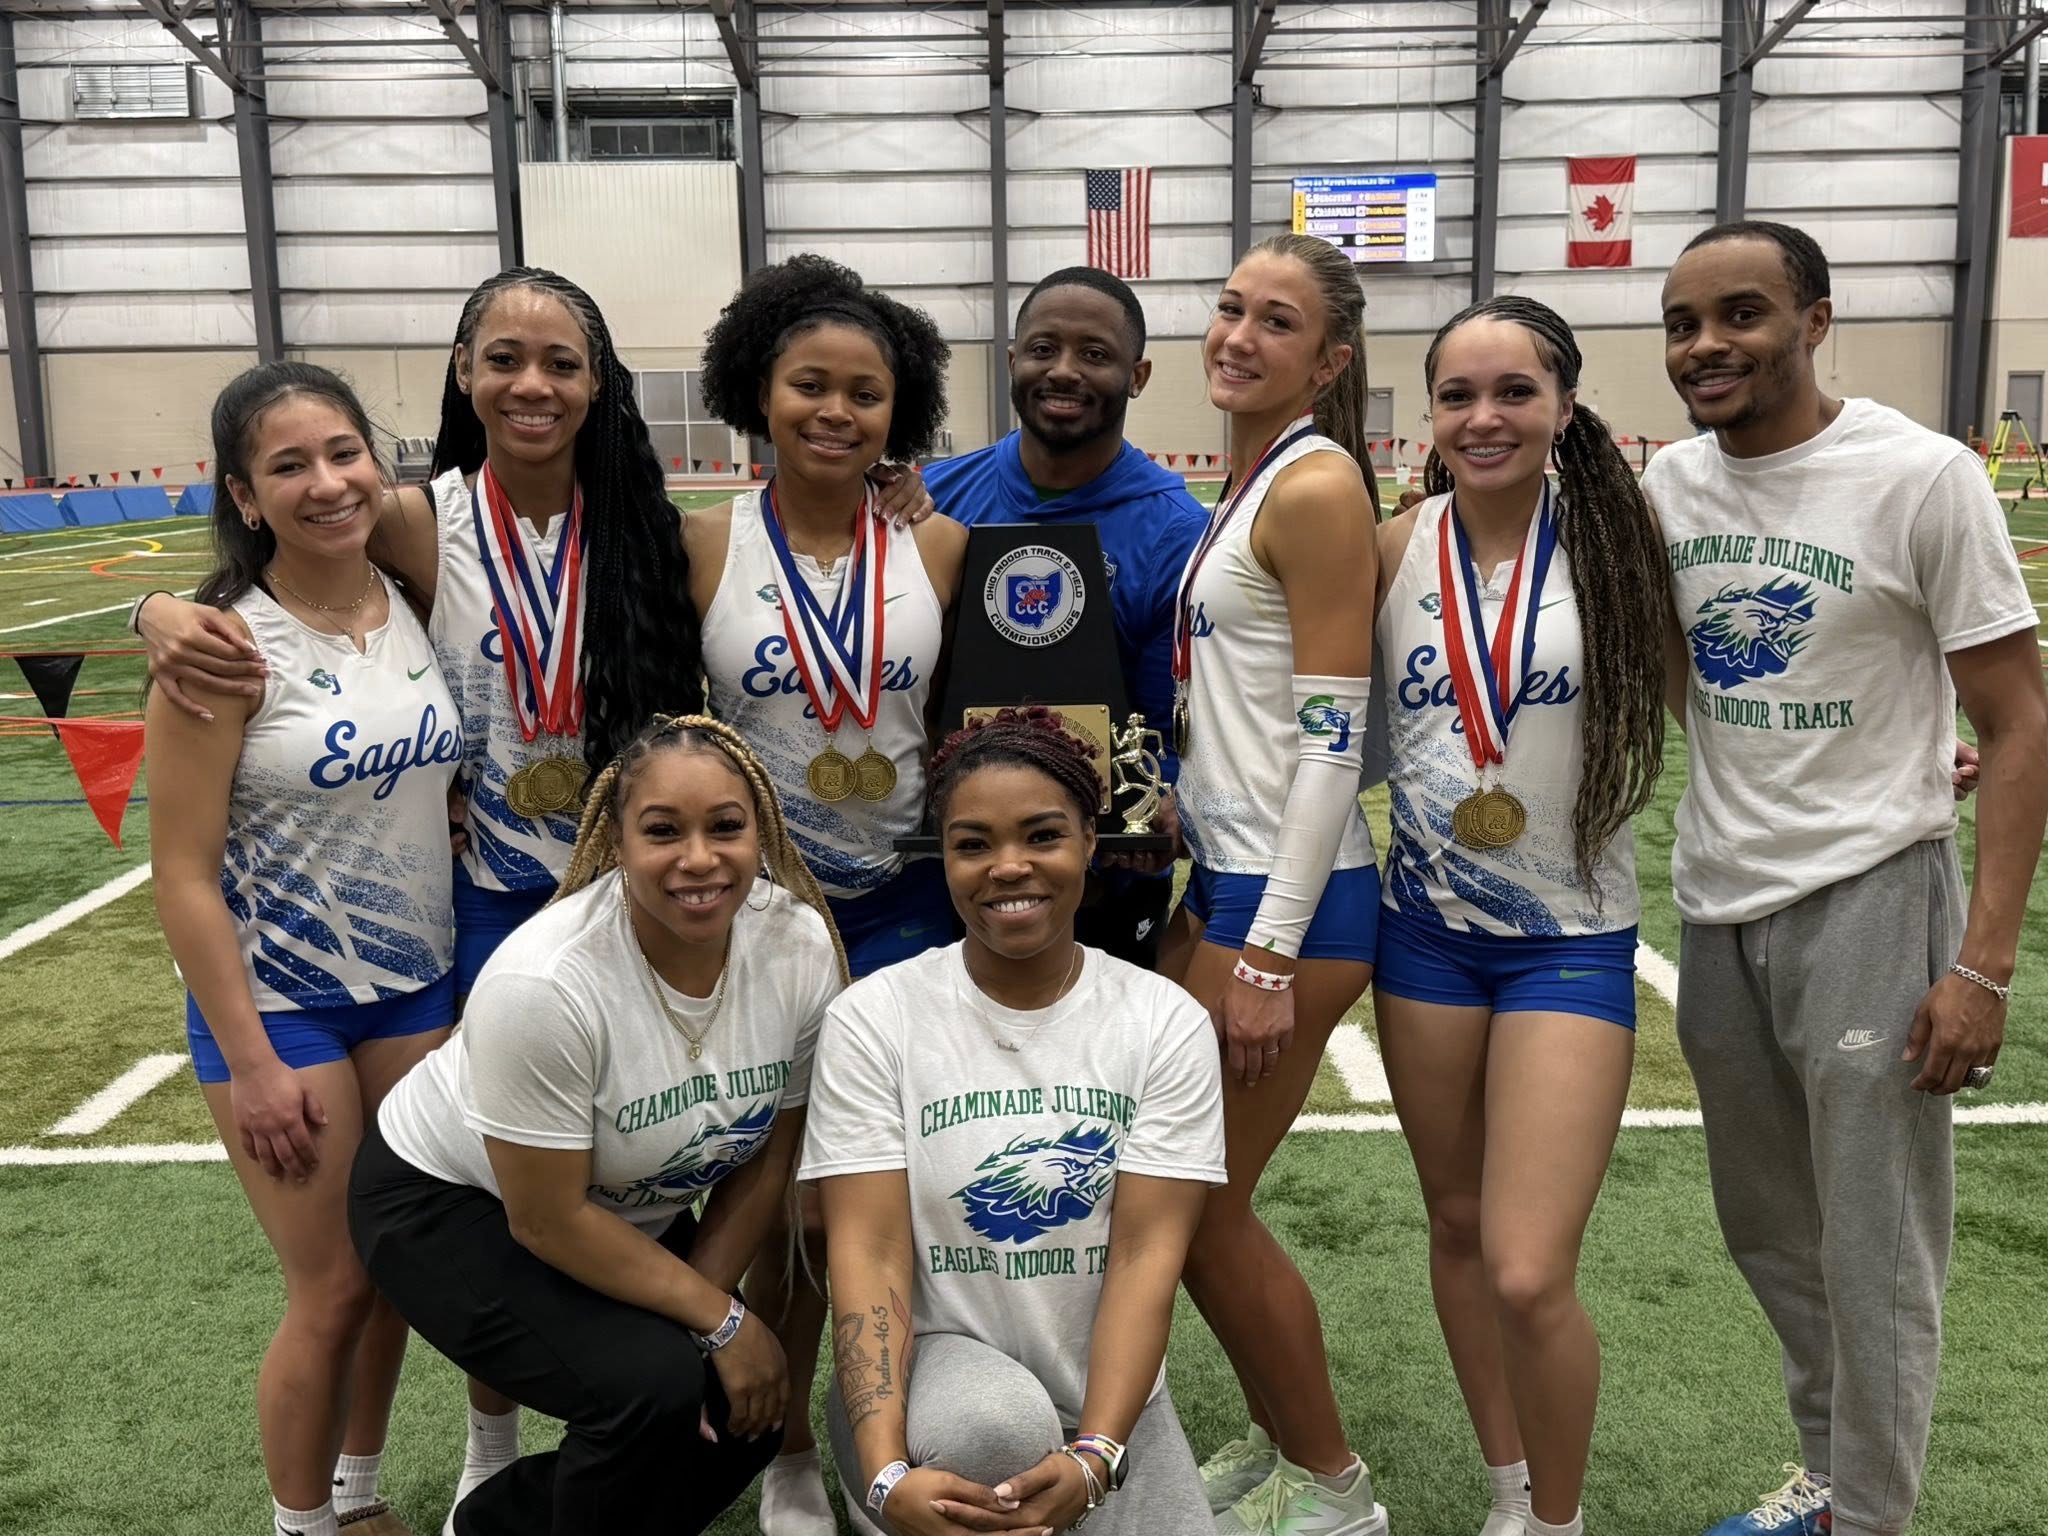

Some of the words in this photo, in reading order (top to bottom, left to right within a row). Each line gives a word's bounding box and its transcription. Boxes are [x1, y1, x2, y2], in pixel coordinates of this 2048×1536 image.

[986, 575, 998, 601] OHIO
[993, 548, 1029, 575] INDOOR
[1030, 547, 1064, 563] TRACK
[1069, 569, 1083, 599] FIELD
[1759, 537, 1855, 594] JULIENNE
[990, 609, 1081, 645] CHAMPIONSHIPS
[741, 634, 920, 720] Eaes
[1398, 644, 1581, 735] Eaes
[1714, 694, 1772, 730] INDOOR
[1780, 700, 1855, 730] TRACK
[308, 703, 464, 801] Eagles
[1843, 1029, 1876, 1043] NIKE
[726, 1059, 793, 1100] JULIENN
[920, 1087, 1044, 1138] CHAMINADE
[929, 1245, 999, 1276] EAGLES
[1005, 1248, 1076, 1281] INDOOR
[871, 1304, 889, 1344] 46:5
